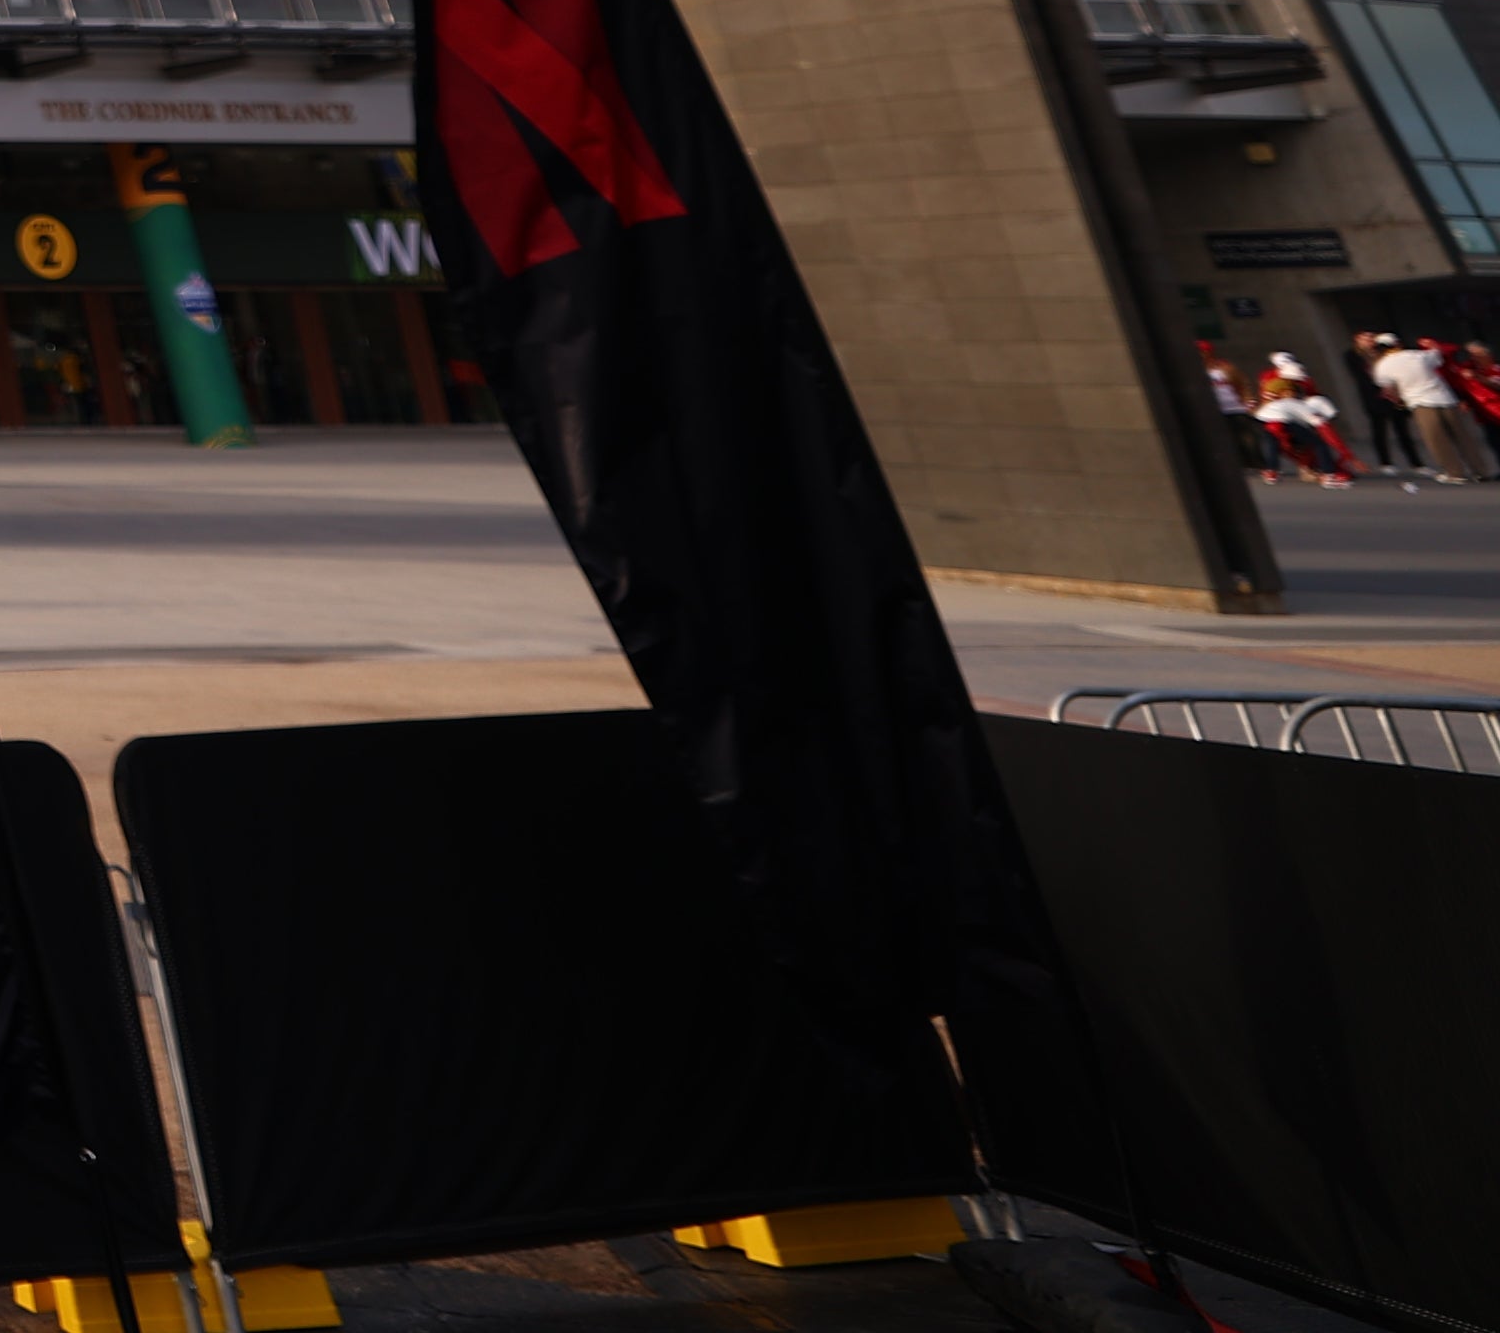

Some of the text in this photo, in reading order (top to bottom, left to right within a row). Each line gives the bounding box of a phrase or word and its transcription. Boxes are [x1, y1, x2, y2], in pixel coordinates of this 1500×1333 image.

[39, 99, 90, 123] THE
[222, 100, 357, 123] ENTRANCE
[34, 234, 62, 268] 2
